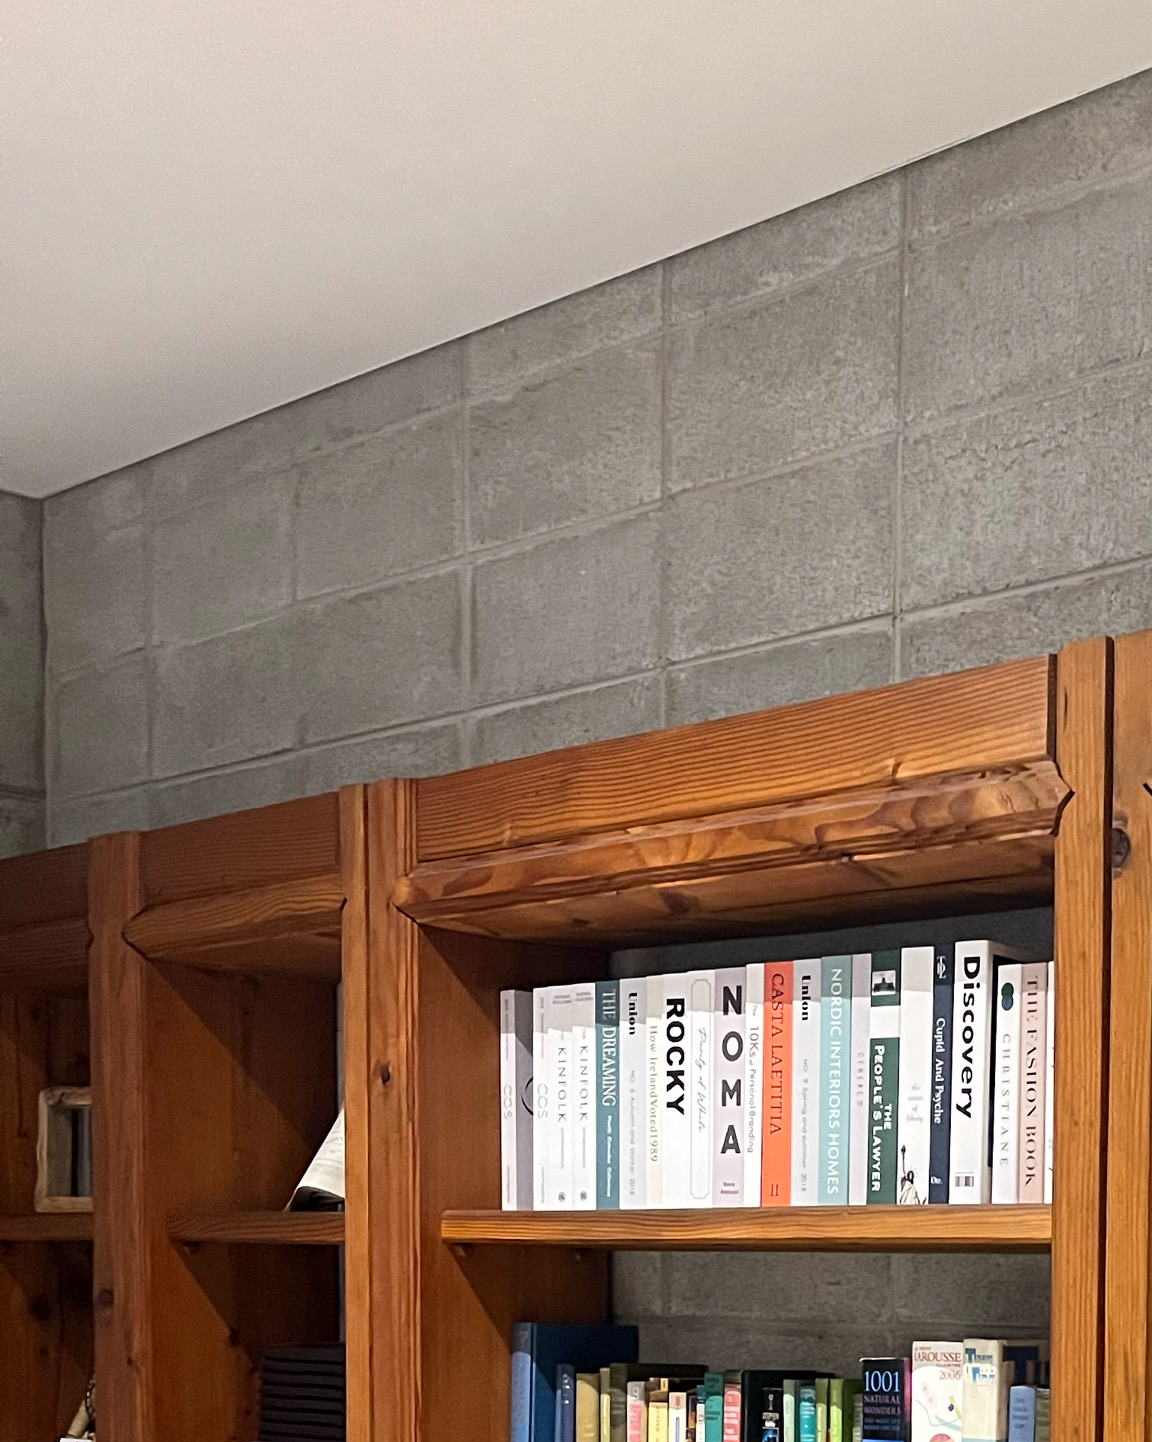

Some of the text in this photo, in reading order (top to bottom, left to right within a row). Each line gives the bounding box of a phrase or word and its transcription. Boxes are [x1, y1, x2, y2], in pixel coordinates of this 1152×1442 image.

[602, 989, 616, 1020] THE
[628, 992, 638, 1035] Union
[802, 975, 811, 1020] Union
[956, 956, 980, 1119] Discovery
[602, 1026, 616, 1106] DREAMING
[666, 998, 685, 1116] ROCKY
[720, 986, 743, 1154] NOMA
[750, 1026, 759, 1056] 10Ks
[770, 974, 784, 1135] CASTA LAETITIA
[933, 1018, 946, 1124] Cupid And Psyche
[558, 1047, 566, 1122] KINFOLK
[580, 1046, 588, 1120] KINFOLK
[827, 969, 842, 1195] NORDIC INTERIORS HOMES
[871, 1046, 885, 1192] PEOPLE'S LAWYER
[883, 1104, 892, 1130] THE
[1001, 1034, 1011, 1166] CHRISTIANE
[1025, 1030, 1038, 1186] FASHION BOOK
[864, 1371, 900, 1392] 1001
[864, 1395, 900, 1404] NATURAL
